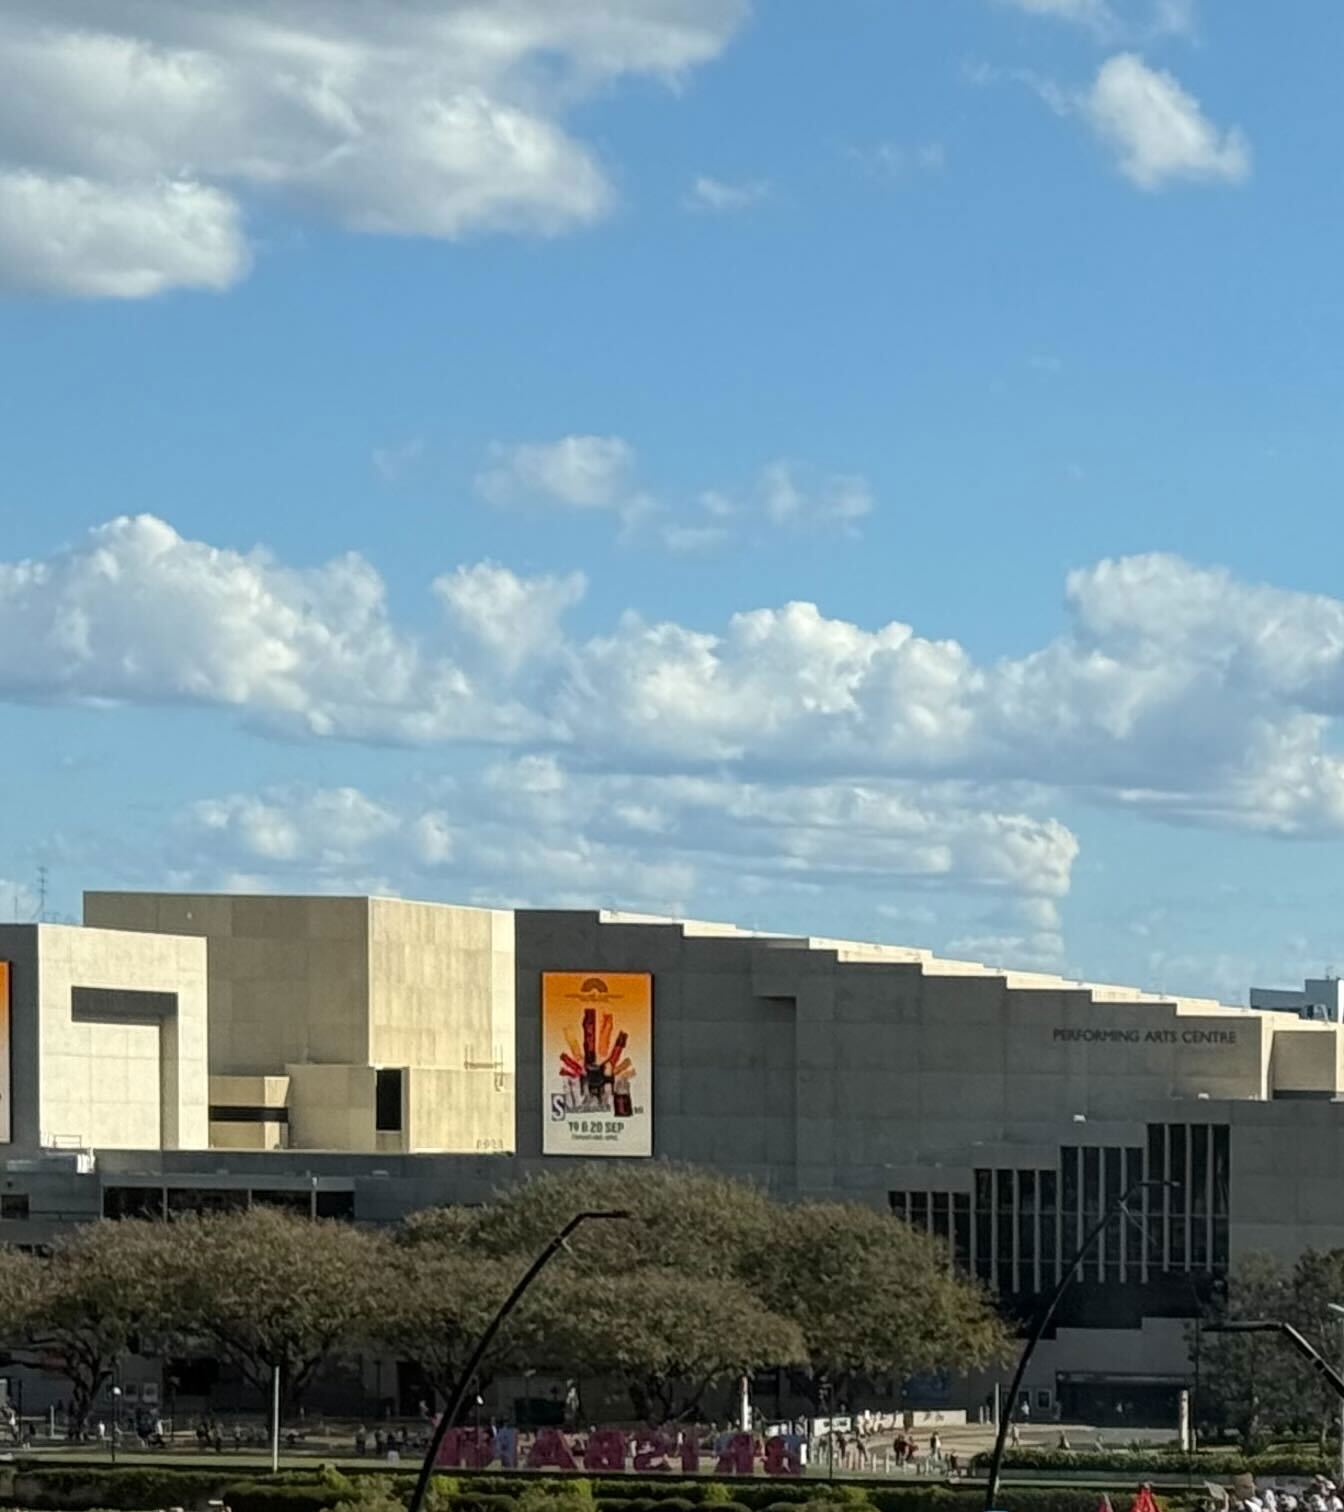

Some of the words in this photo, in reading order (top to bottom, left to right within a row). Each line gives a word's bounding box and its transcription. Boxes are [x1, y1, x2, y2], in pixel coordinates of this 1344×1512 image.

[1053, 1027, 1139, 1043] PERFORMING
[1144, 1029, 1178, 1044] ARTS
[1181, 1030, 1237, 1045] CENTRE
